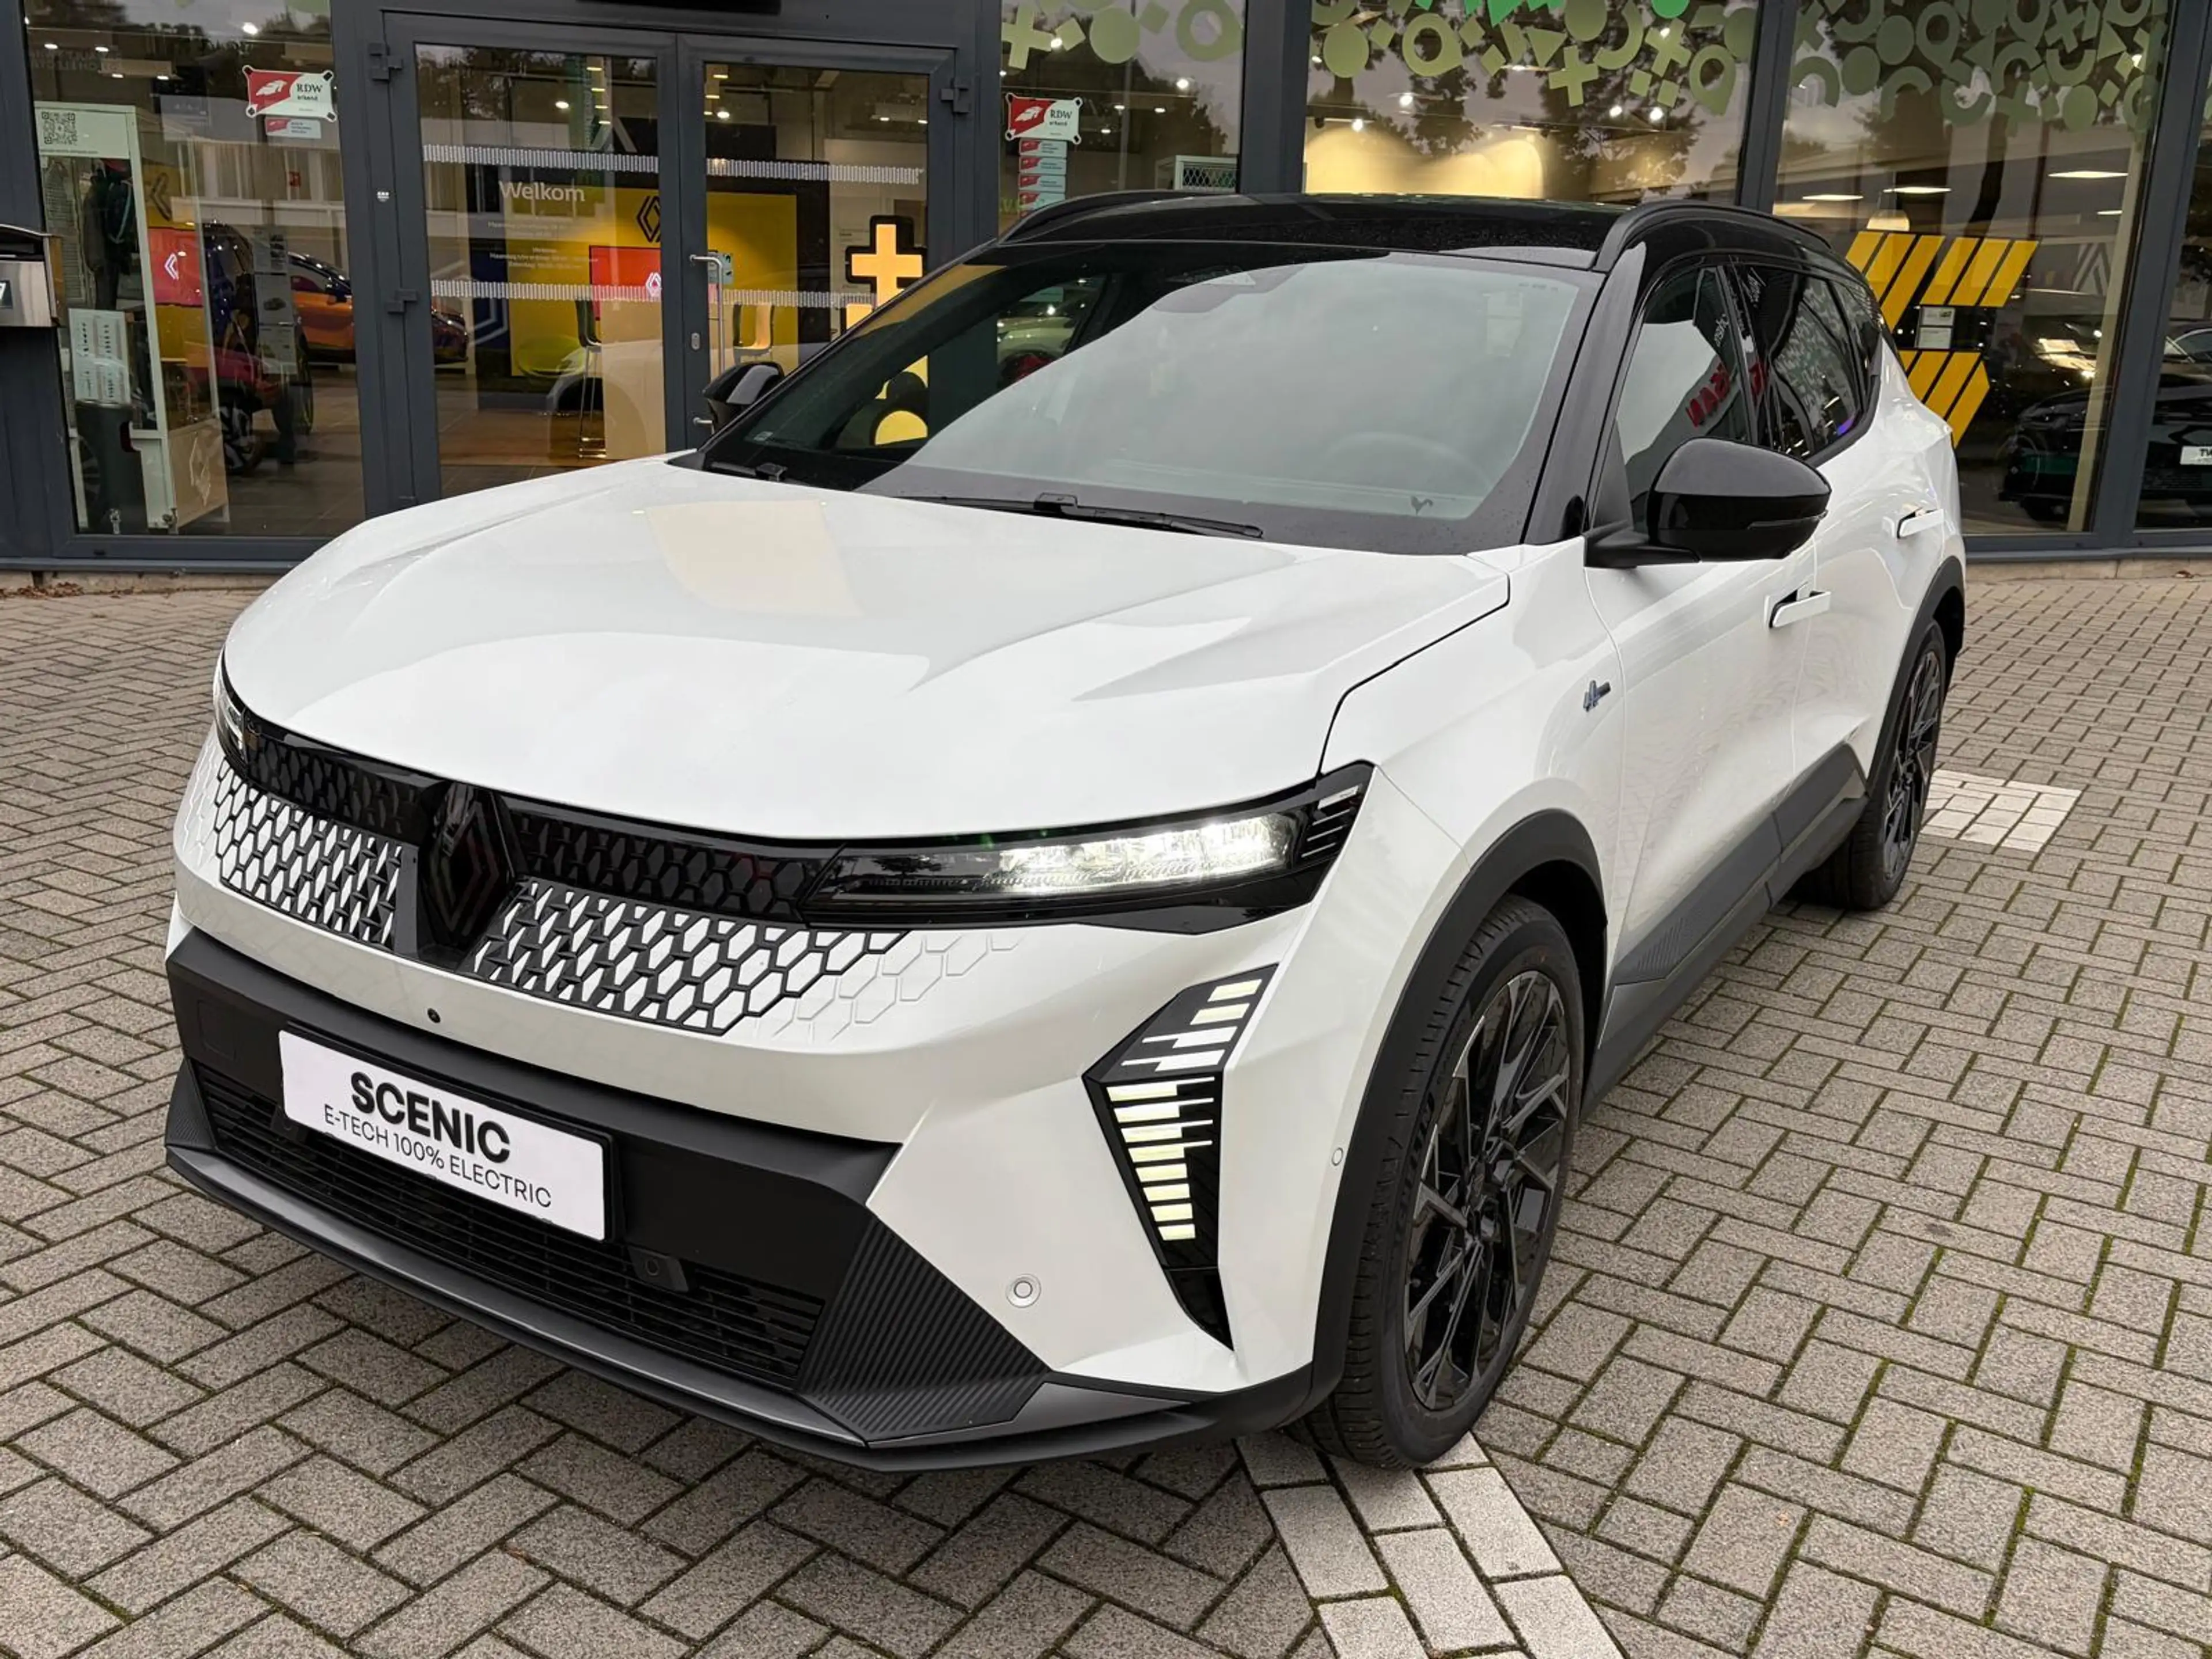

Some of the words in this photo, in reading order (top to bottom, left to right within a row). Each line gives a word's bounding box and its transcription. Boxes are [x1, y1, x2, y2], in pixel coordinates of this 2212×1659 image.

[297, 83, 323, 93] RDW
[1050, 109, 1073, 119] RDW
[498, 180, 585, 202] Welkom
[351, 1071, 511, 1164] SCENIC
[324, 1104, 389, 1147] E-TECH
[393, 1132, 445, 1170] 100%
[450, 1154, 552, 1209] ELECTRIC
